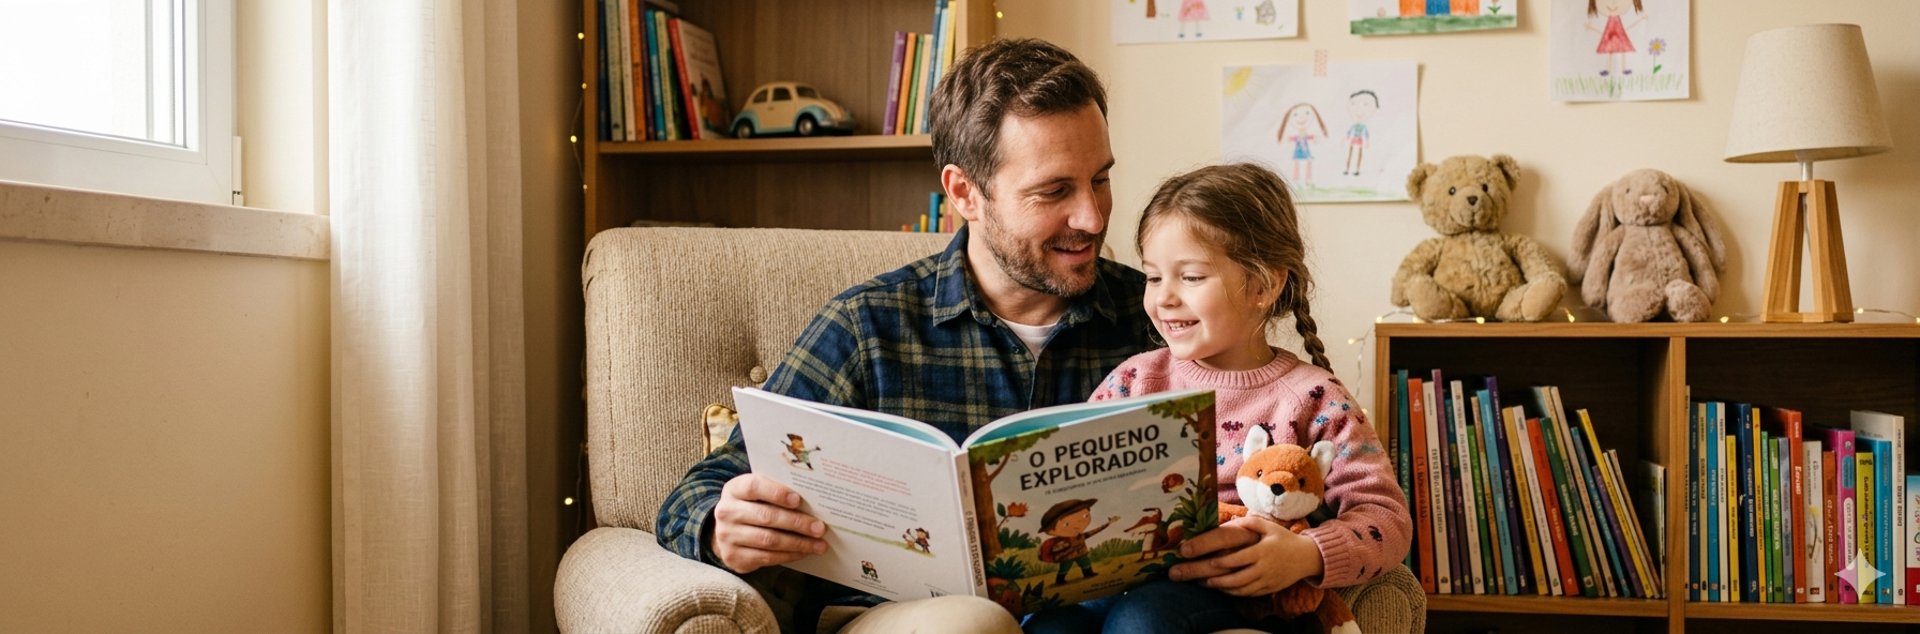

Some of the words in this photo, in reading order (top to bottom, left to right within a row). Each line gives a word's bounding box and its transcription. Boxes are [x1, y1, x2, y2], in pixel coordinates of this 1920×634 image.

[1020, 442, 1169, 491] EXPLORADOR
[1029, 451, 1045, 468] O
[1054, 424, 1160, 463] PEQUENO
